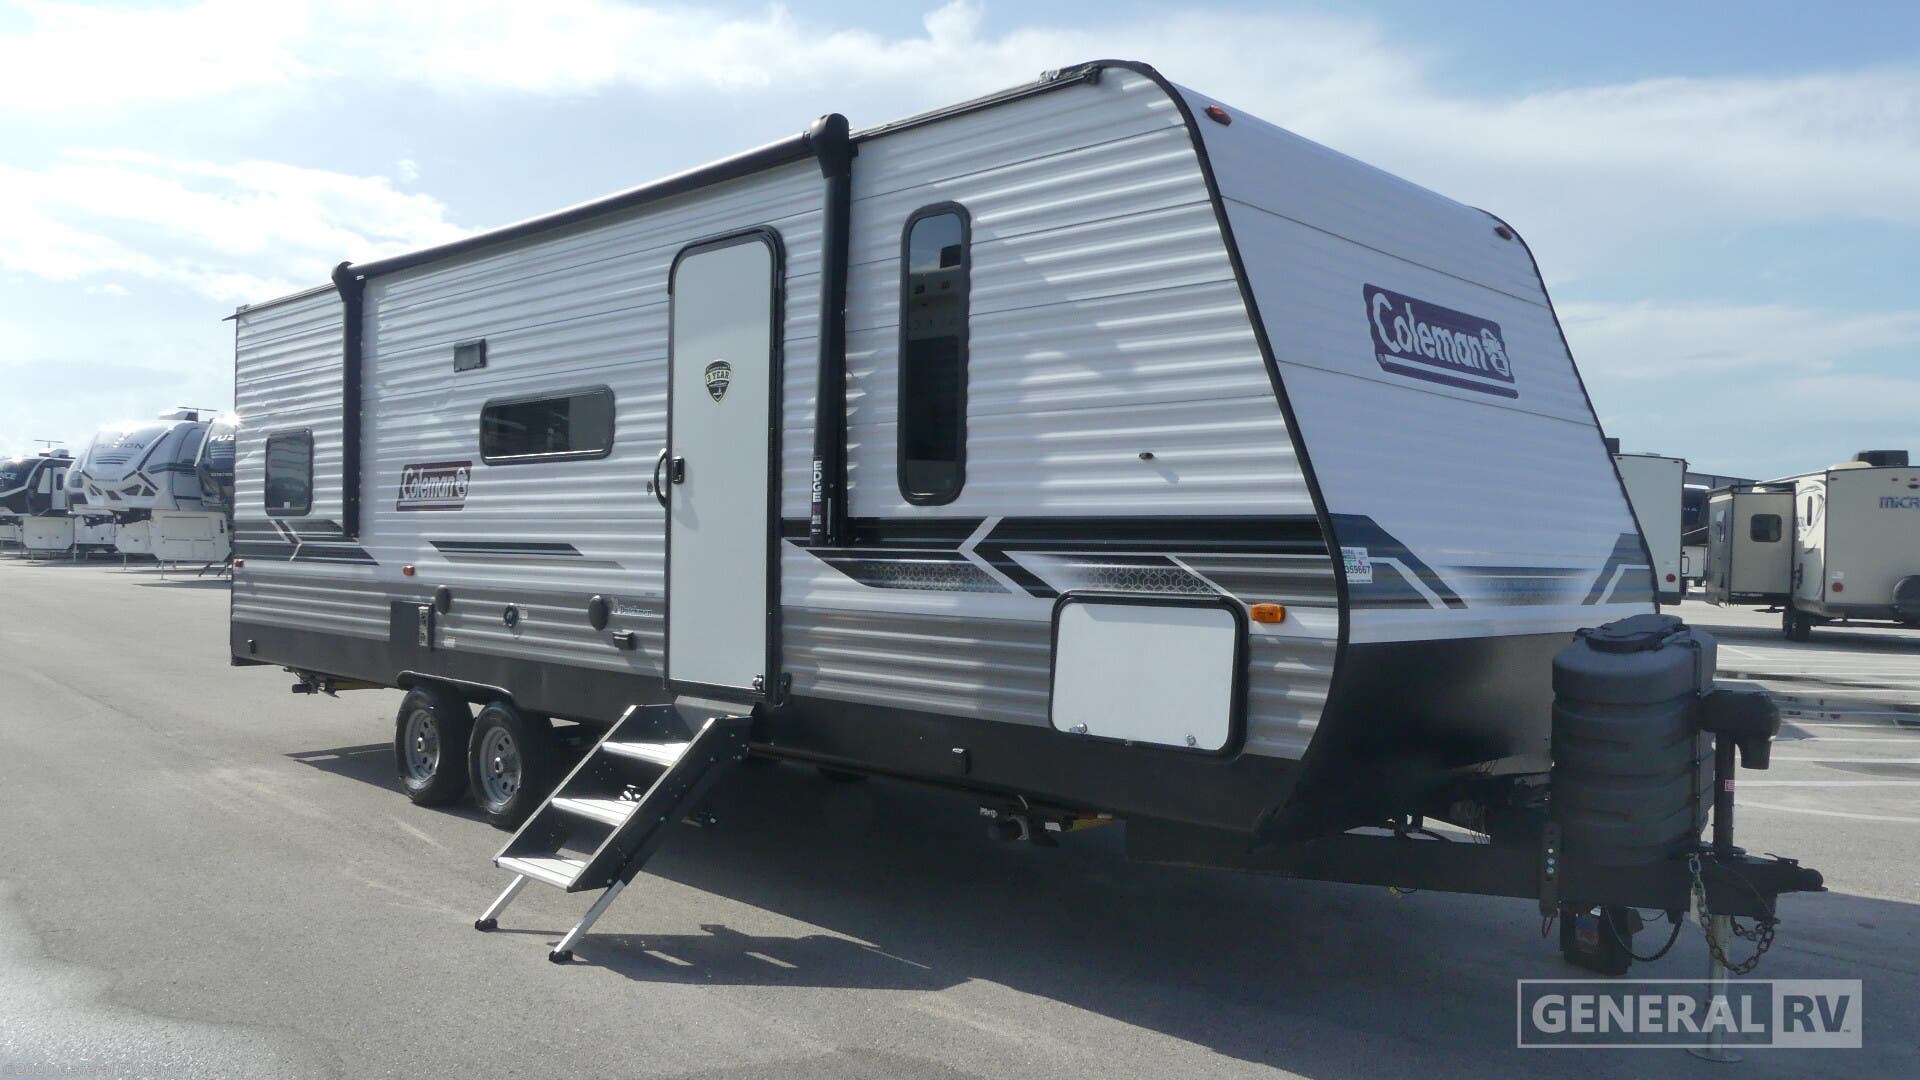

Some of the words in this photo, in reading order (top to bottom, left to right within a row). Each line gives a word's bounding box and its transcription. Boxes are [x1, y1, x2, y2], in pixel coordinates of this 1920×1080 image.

[1373, 292, 1489, 371] Coleman
[402, 467, 456, 500] Coleman
[812, 460, 823, 503] EDGE
